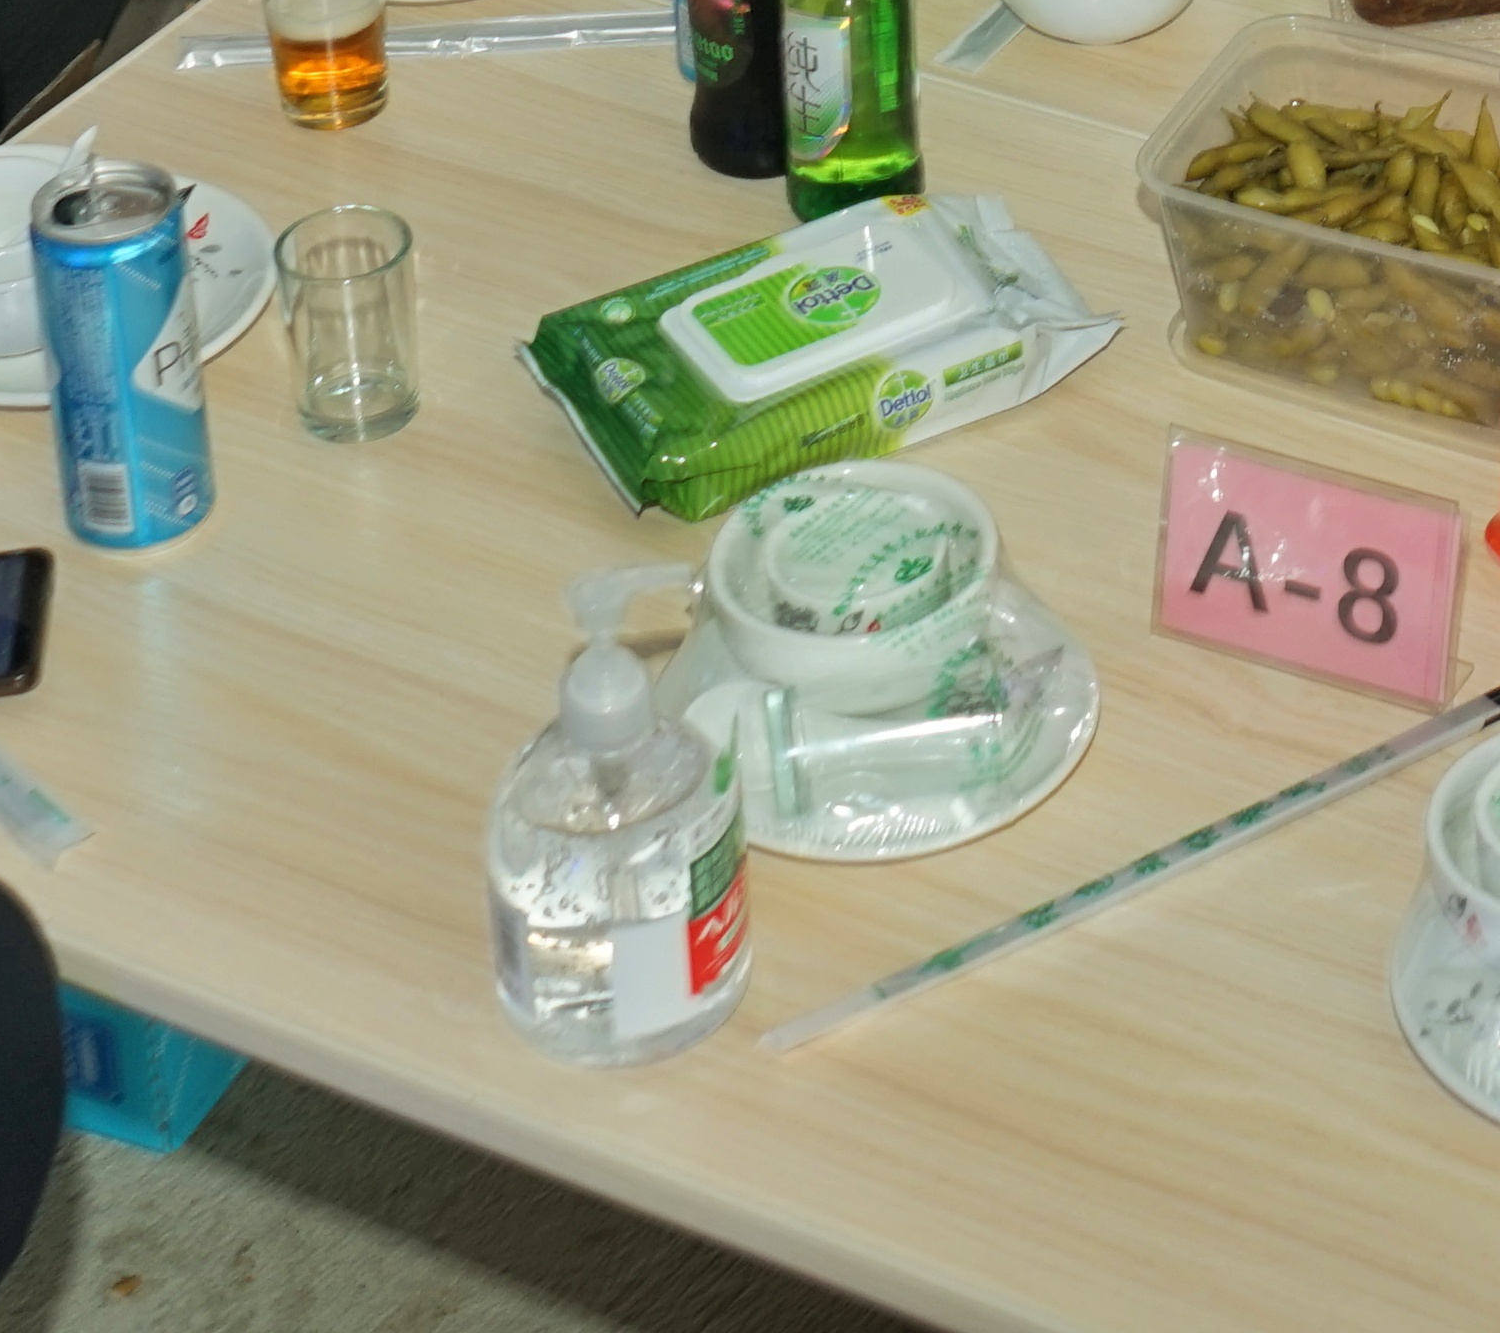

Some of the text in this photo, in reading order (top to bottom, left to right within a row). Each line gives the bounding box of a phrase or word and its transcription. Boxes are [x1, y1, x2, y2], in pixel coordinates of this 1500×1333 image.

[794, 273, 876, 315] Dettol
[878, 382, 932, 417] Dettol
[1190, 508, 1400, 645] A-8
